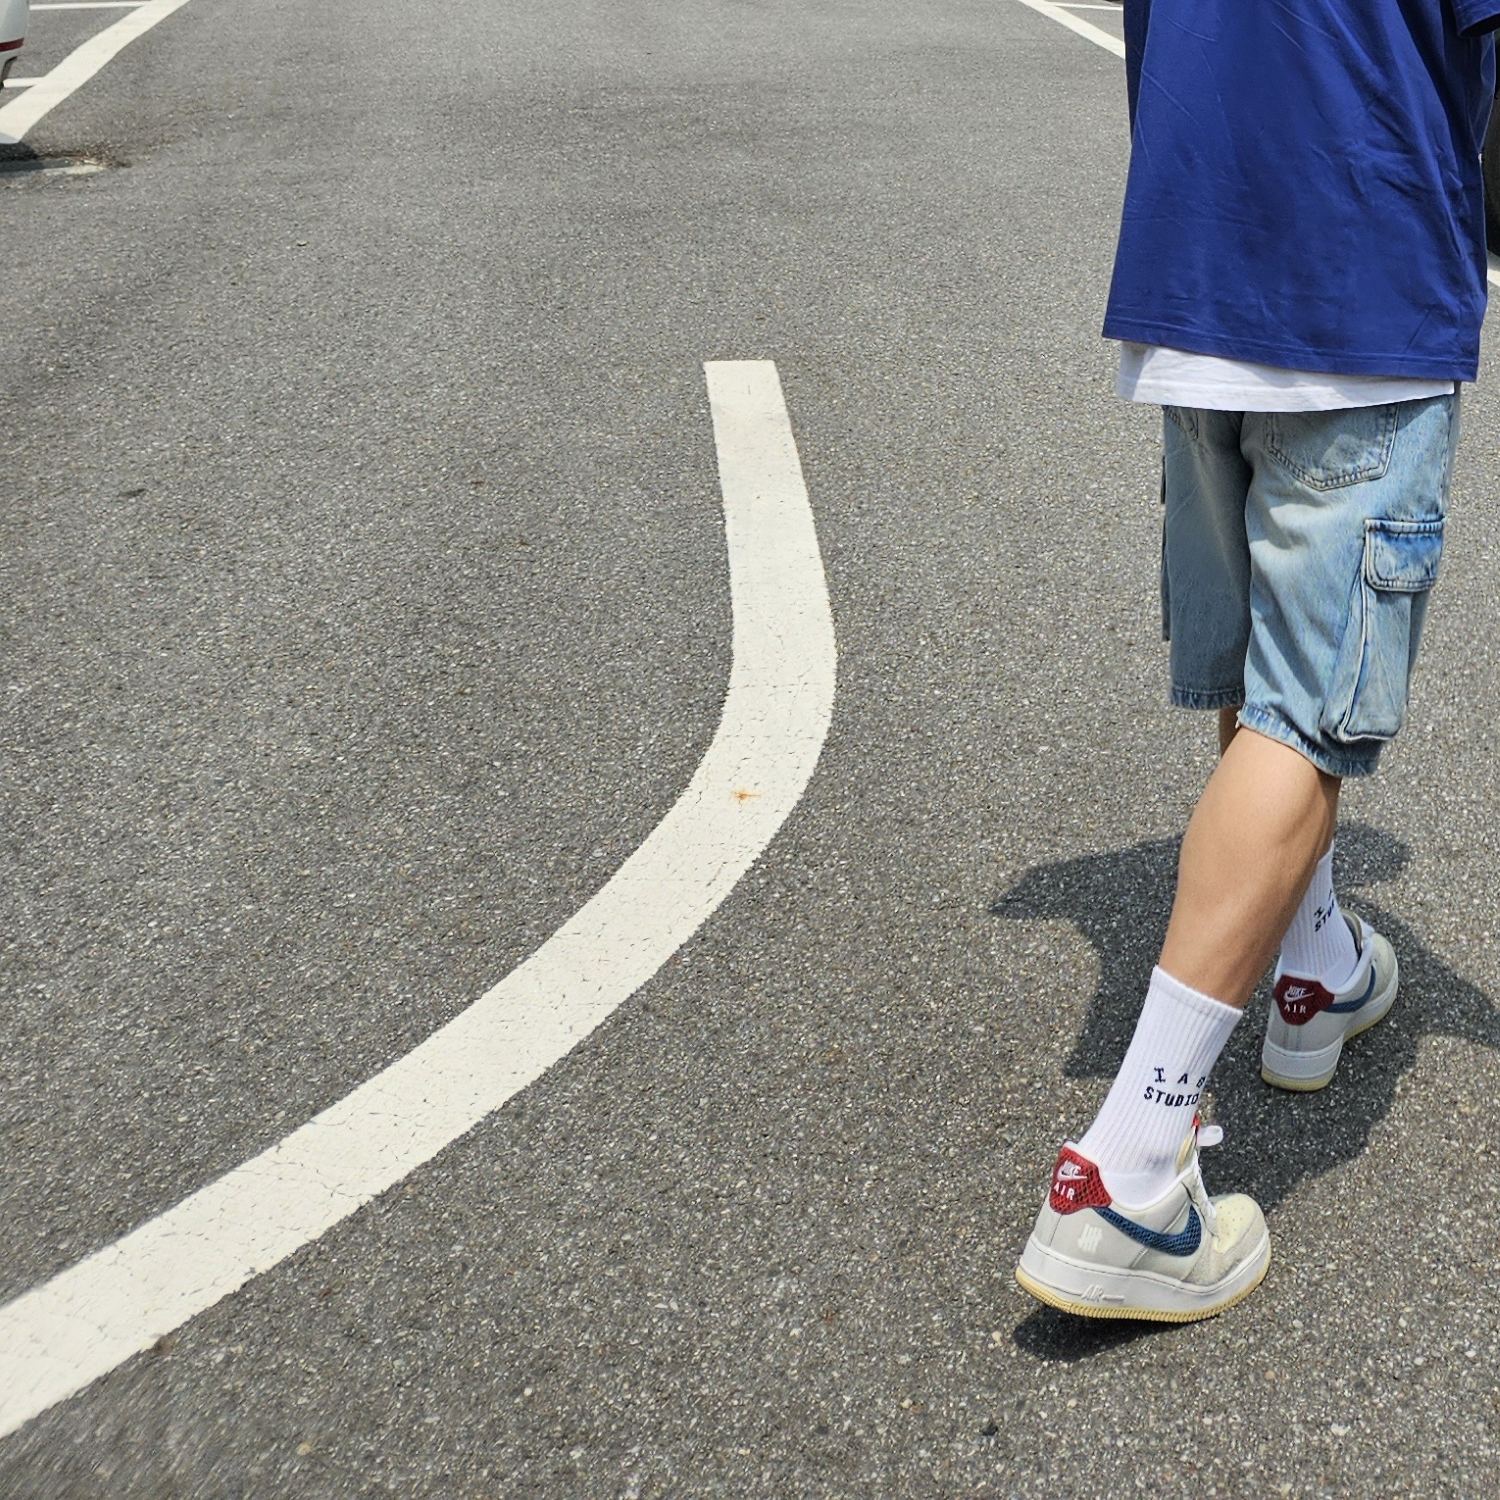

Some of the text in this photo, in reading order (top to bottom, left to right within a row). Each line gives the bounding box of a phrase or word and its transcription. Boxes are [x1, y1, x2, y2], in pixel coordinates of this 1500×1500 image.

[1283, 1003, 1307, 1015] AIR
[1143, 1085, 1200, 1107] STUDIO
[1053, 1181, 1076, 1201] AIR
